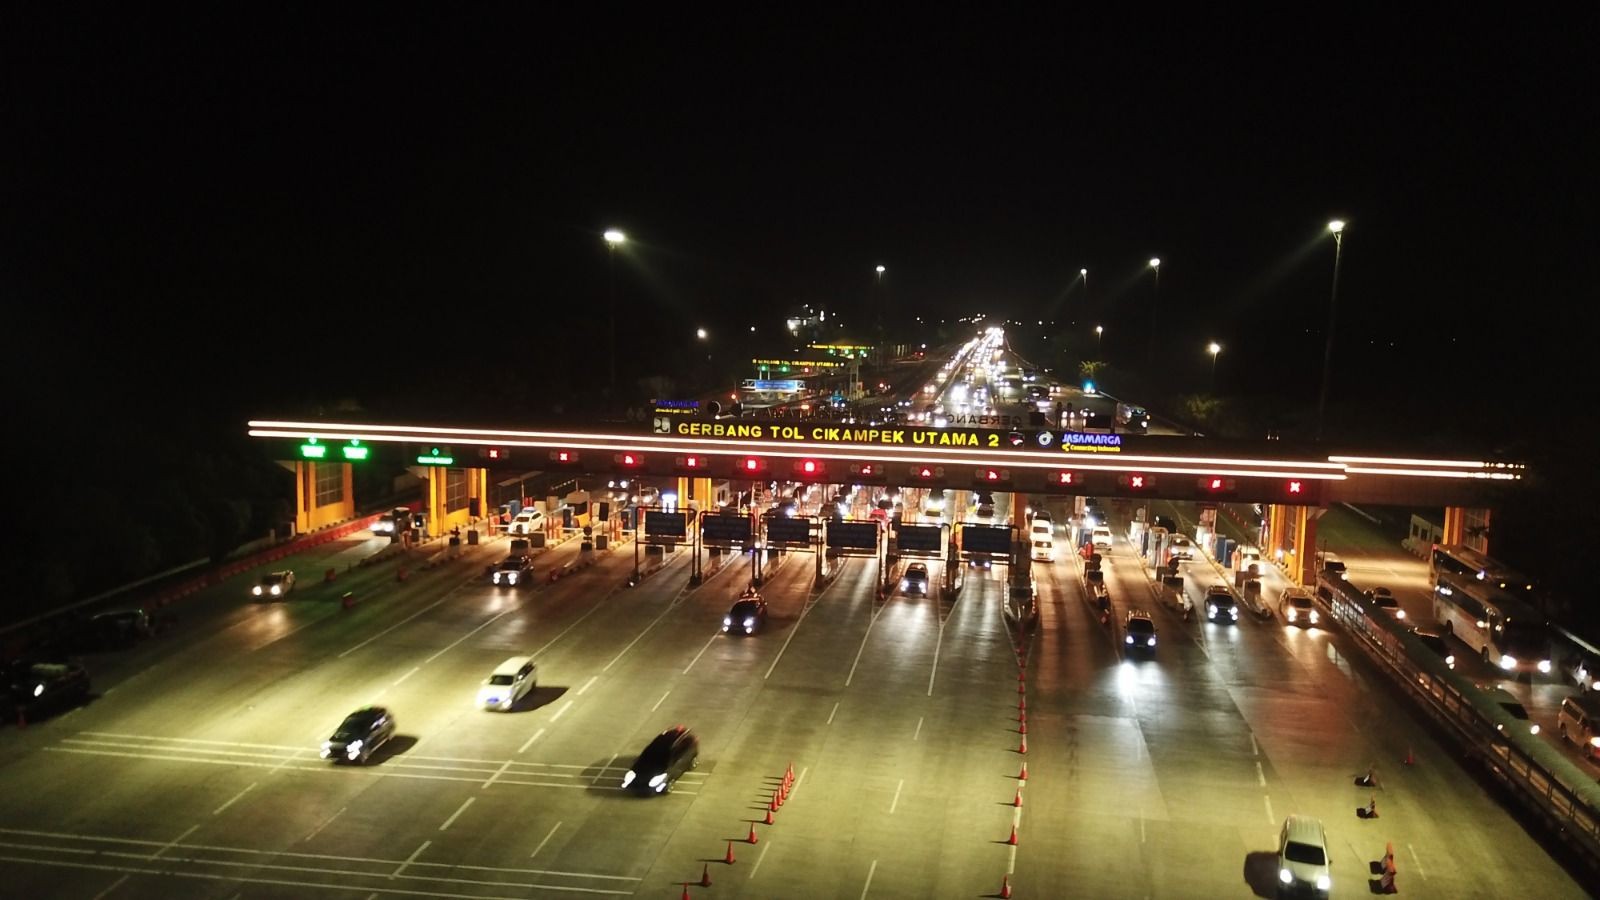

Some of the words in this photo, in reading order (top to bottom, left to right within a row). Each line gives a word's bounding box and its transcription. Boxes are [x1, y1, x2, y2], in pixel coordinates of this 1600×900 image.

[678, 423, 763, 438] GERBANG
[769, 426, 805, 440] TOL
[812, 428, 905, 444] CIKAMPEK
[912, 431, 980, 447] UTAMA
[988, 433, 1000, 448] 2
[1062, 434, 1121, 445] JASAMARGA
